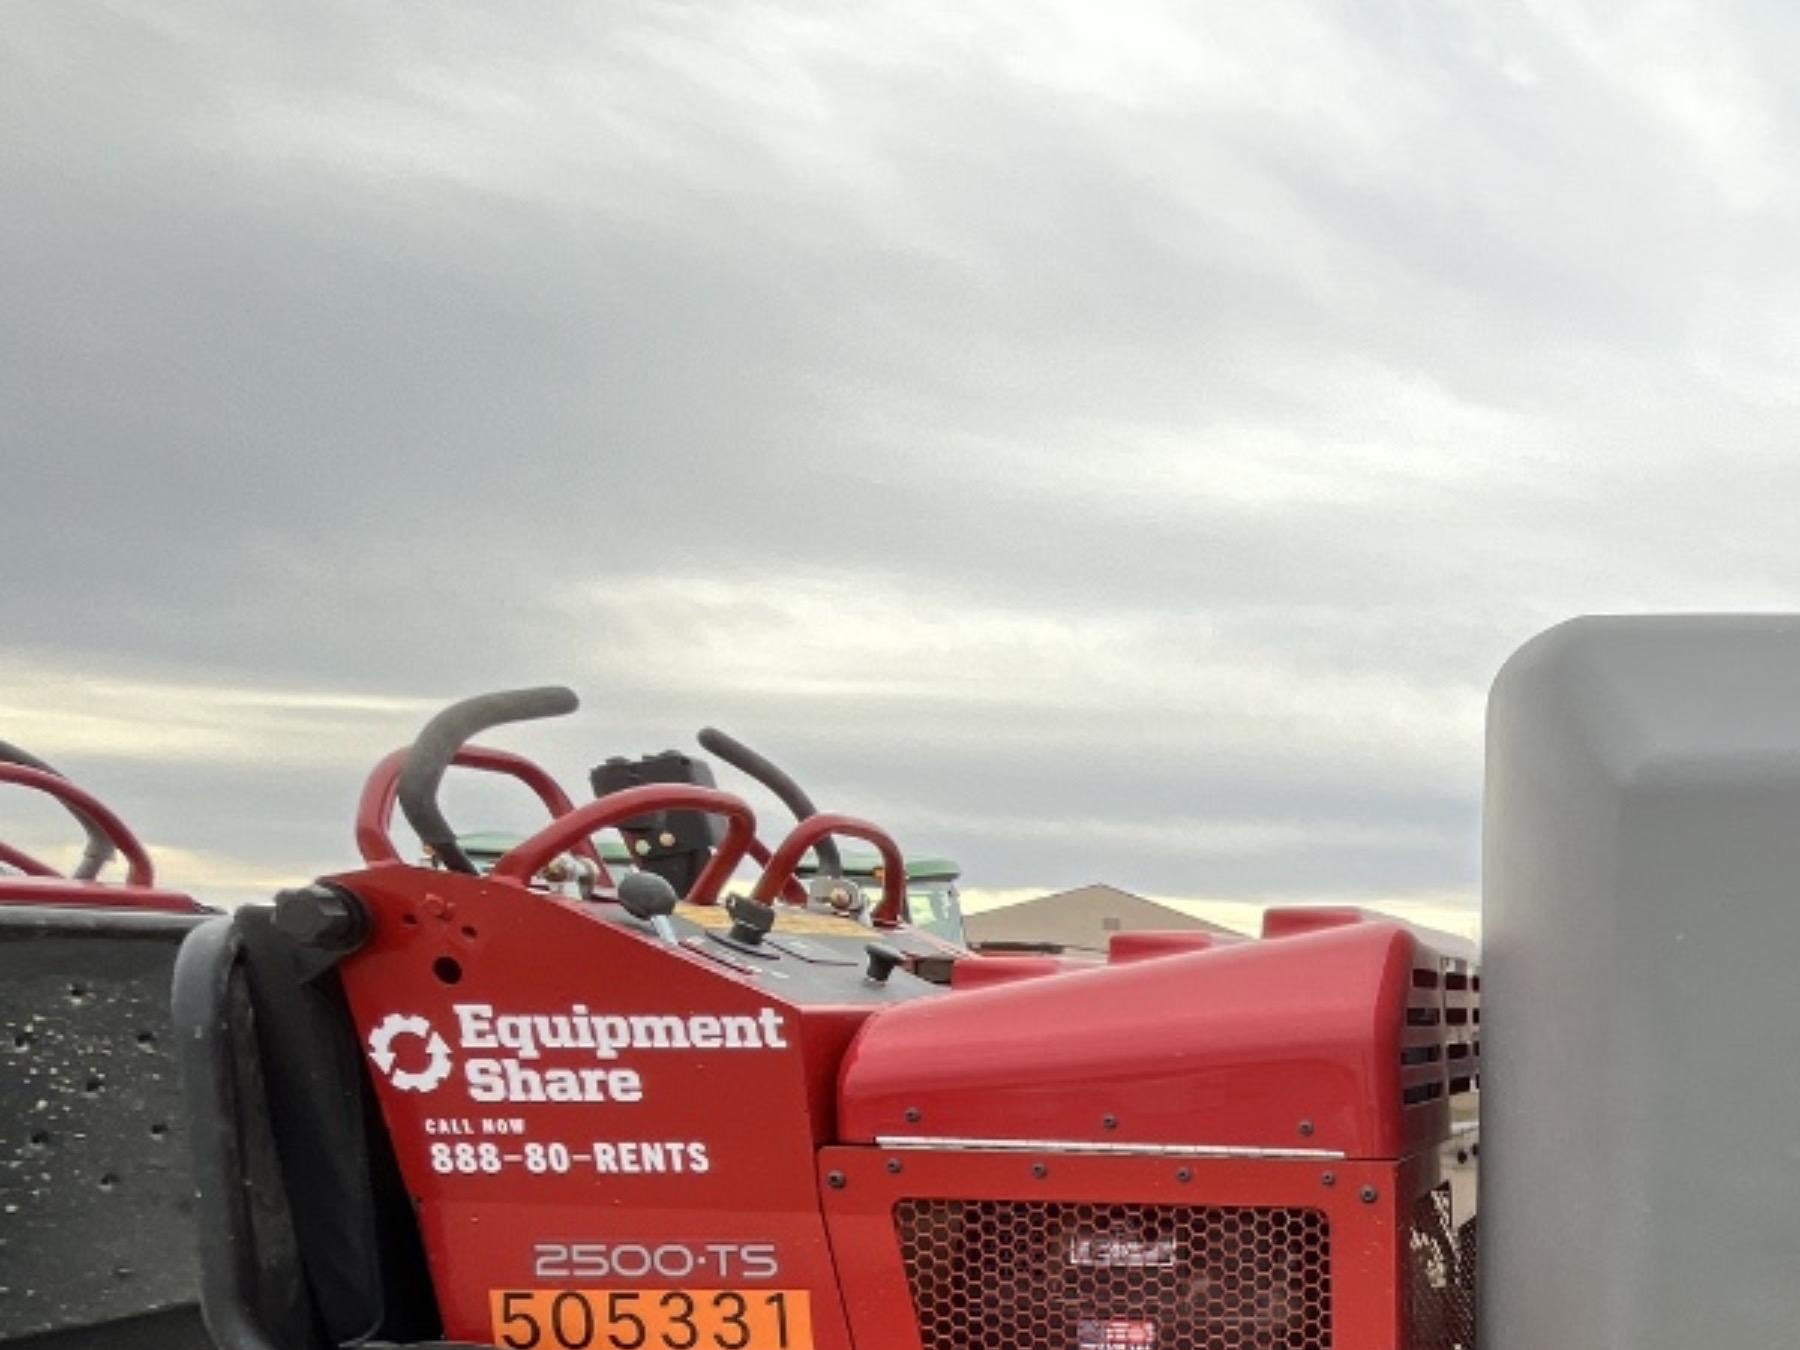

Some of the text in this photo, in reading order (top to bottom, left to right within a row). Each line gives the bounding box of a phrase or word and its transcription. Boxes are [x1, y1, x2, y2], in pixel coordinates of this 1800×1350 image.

[452, 1003, 788, 1060] Equipment
[464, 1058, 643, 1102] Share
[424, 1118, 526, 1135] CALL NOW
[430, 1141, 710, 1174] 888-80-RENTS
